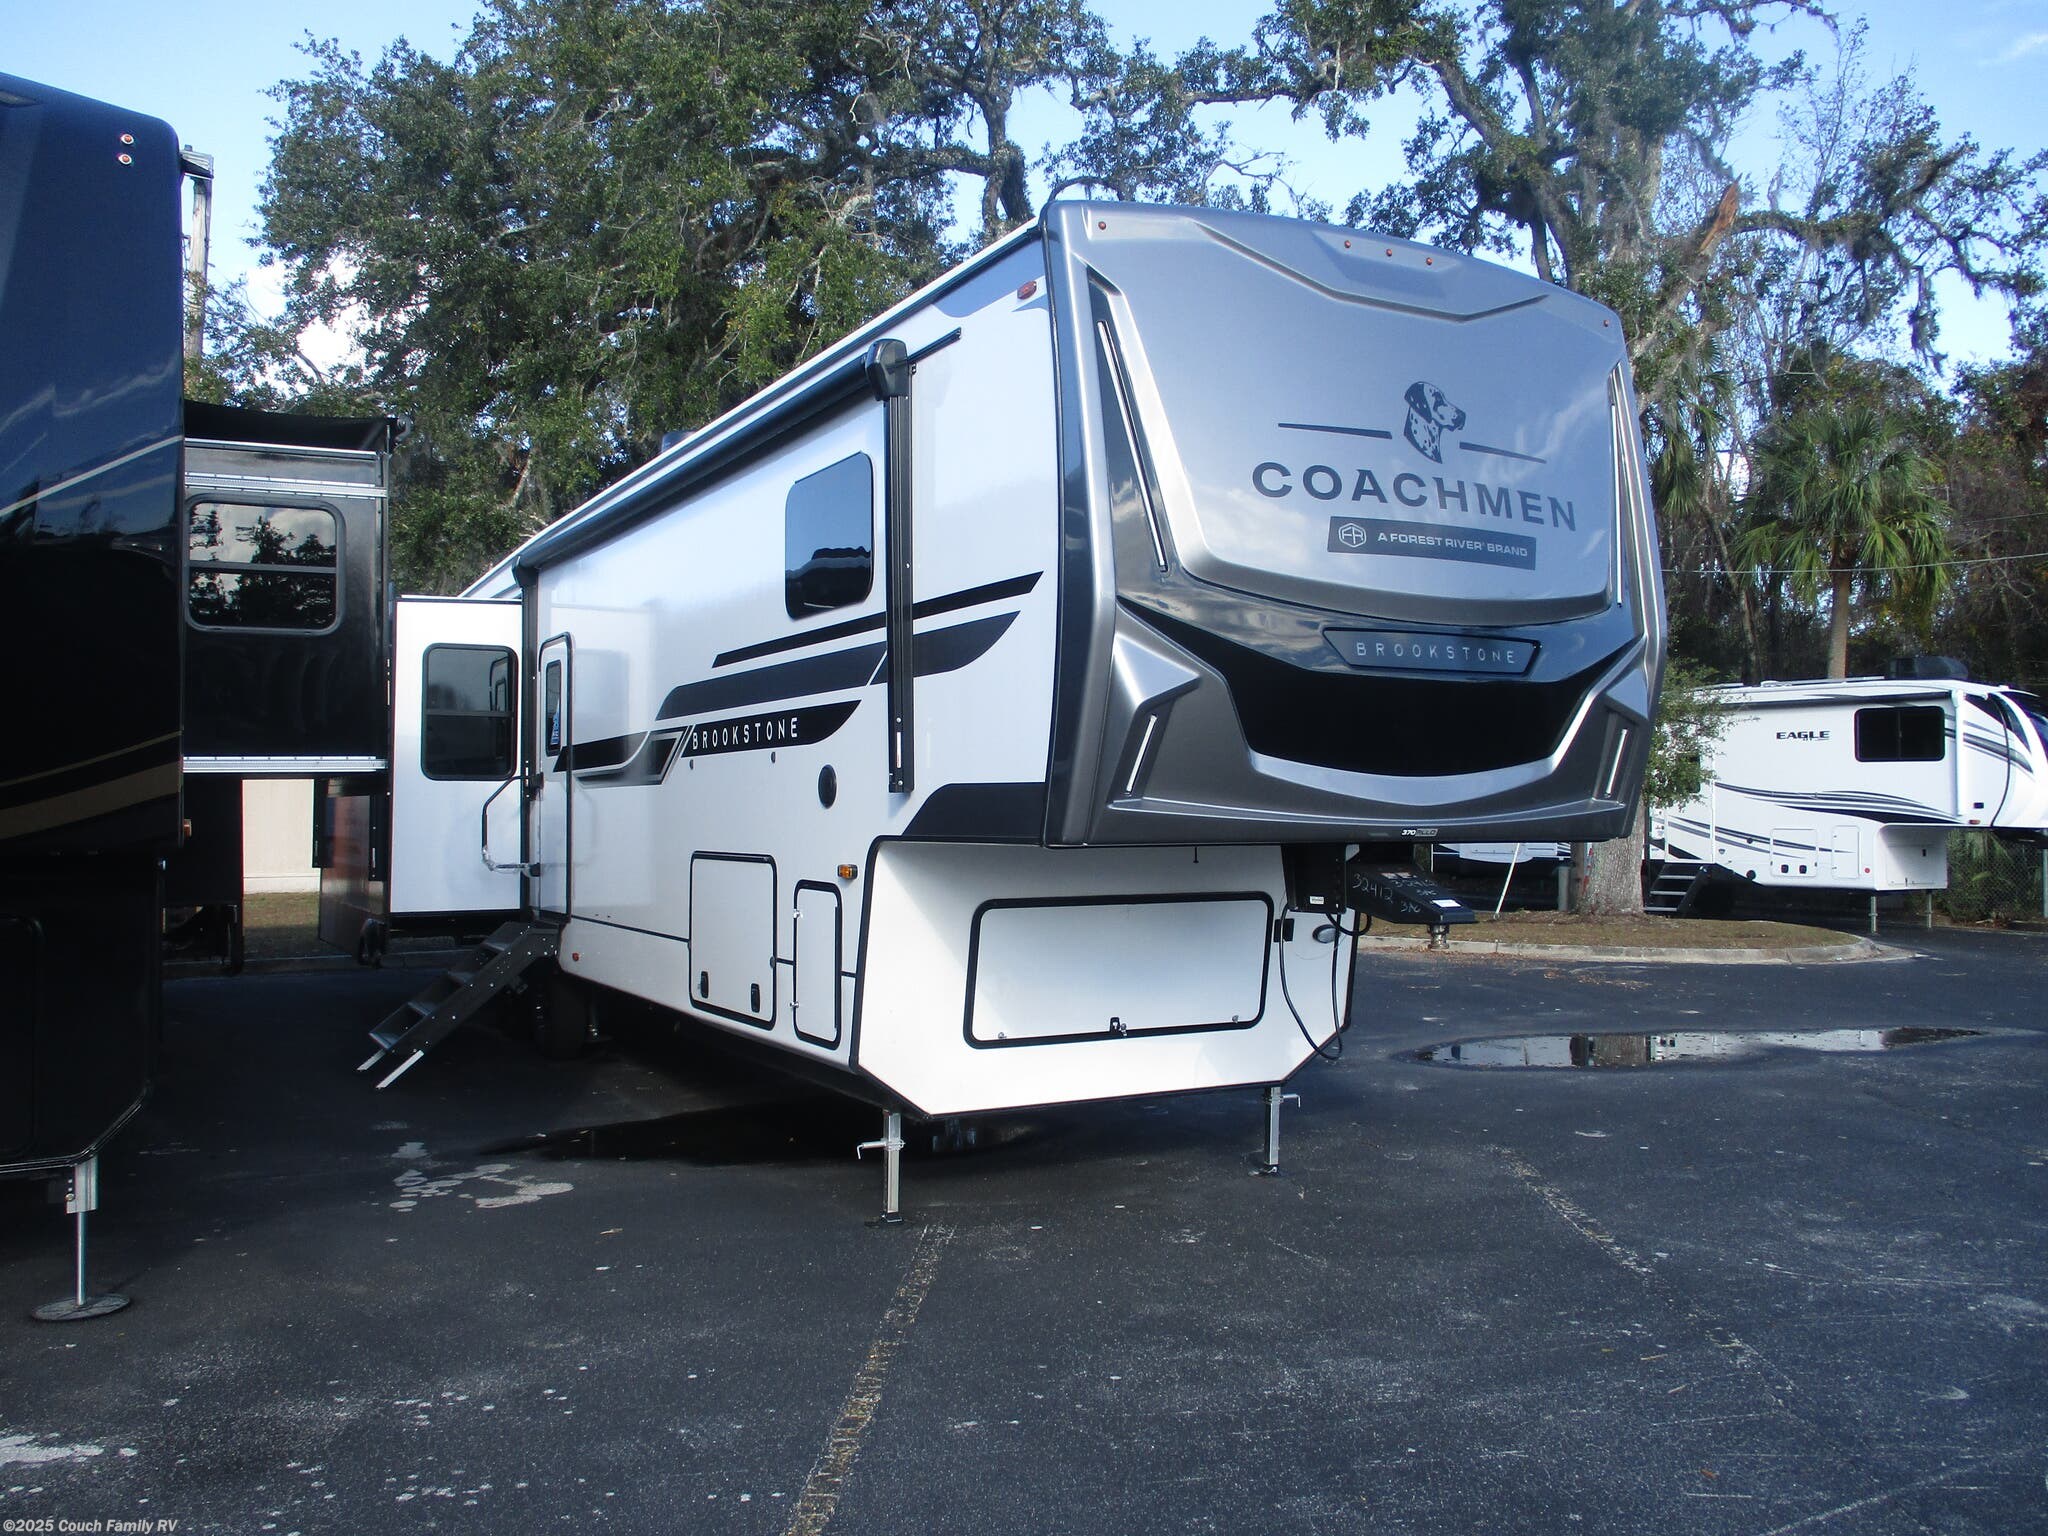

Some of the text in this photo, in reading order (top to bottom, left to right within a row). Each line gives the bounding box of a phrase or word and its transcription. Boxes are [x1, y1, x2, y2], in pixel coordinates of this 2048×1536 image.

[1252, 461, 1576, 532] COACHMEN
[1377, 532, 1388, 542] A
[1390, 533, 1443, 546] FOREST
[1487, 543, 1528, 557] BRAND
[1356, 642, 1516, 664] BROOKSTONE
[692, 717, 798, 750] BROOKSTONE
[1776, 730, 1831, 740] EAGLE
